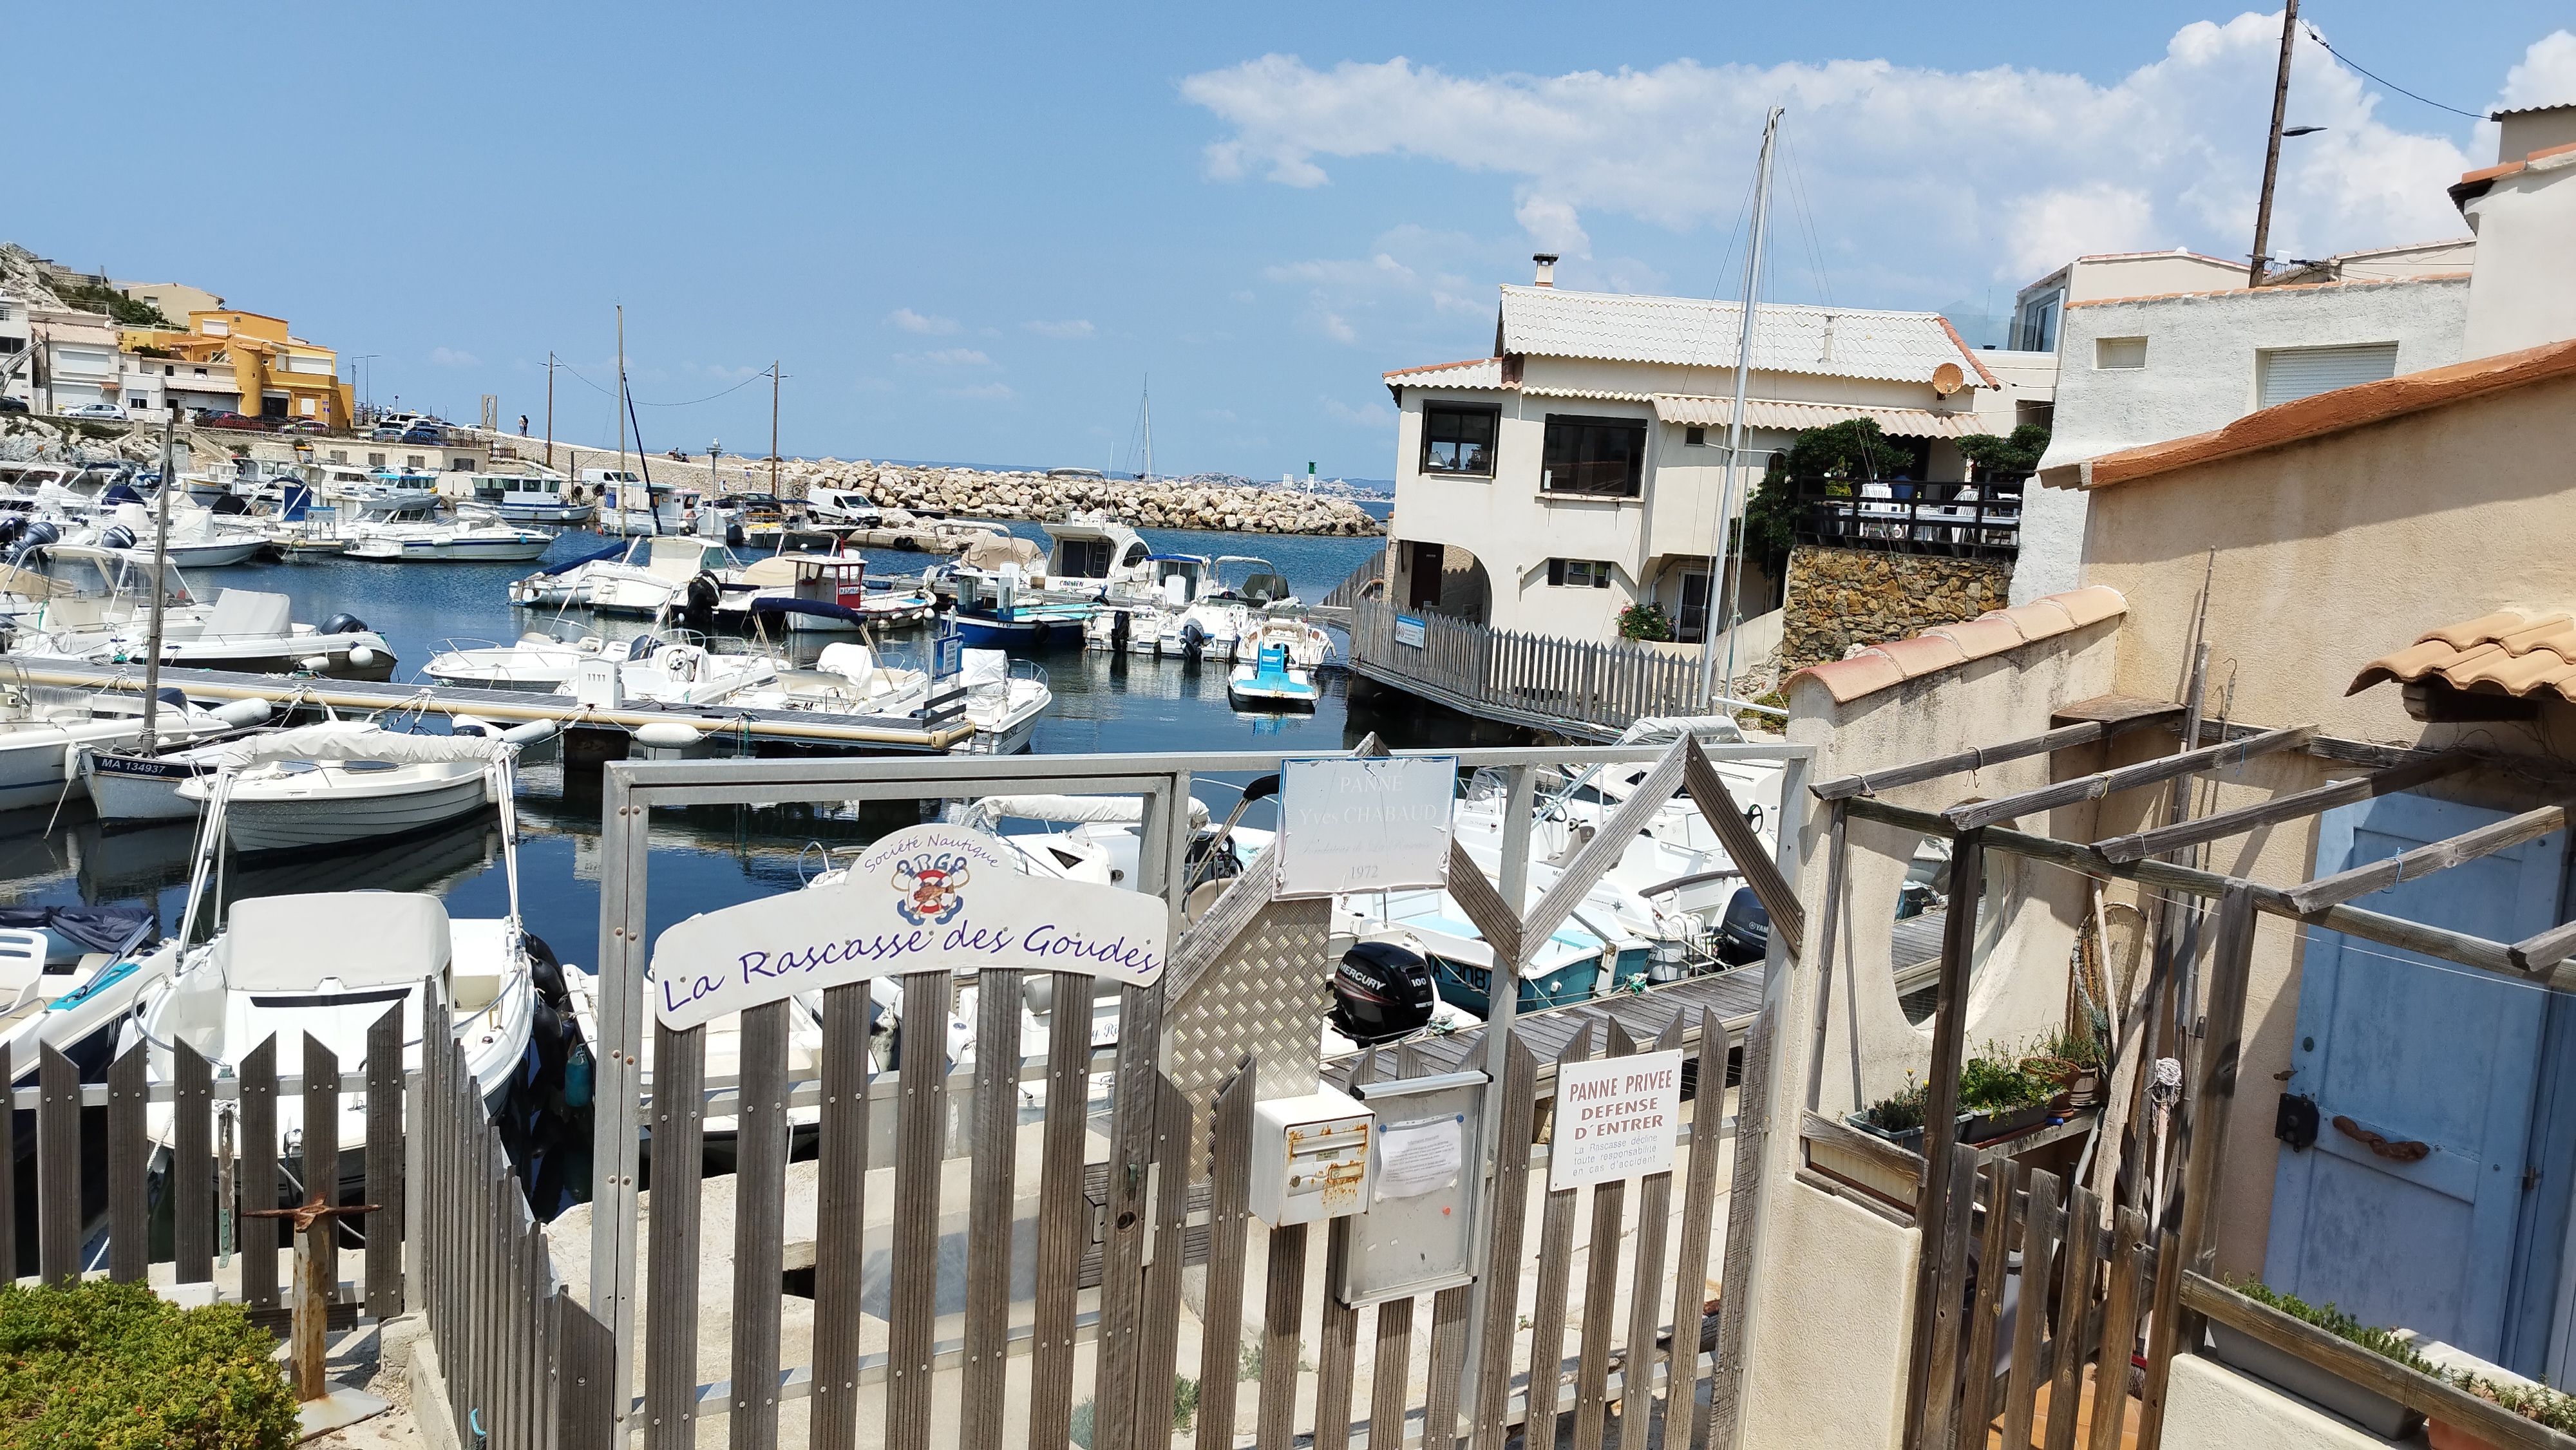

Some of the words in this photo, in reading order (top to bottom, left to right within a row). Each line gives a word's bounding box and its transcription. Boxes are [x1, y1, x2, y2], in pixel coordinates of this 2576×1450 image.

[102, 758, 121, 769] MA
[126, 762, 166, 774] 134937
[1339, 775, 1403, 793] PANNE
[1299, 809, 1338, 825] Yves
[1343, 804, 1437, 824] CHABAUD
[864, 835, 923, 873] Société
[927, 833, 999, 868] Nautique
[1352, 865, 1379, 880] 1972
[1755, 923, 1769, 933] YAM
[663, 975, 725, 1012] La
[739, 929, 934, 984] Rascasse
[943, 919, 1015, 954] des
[1023, 924, 1161, 974] Goudes
[1339, 961, 1386, 991] MERCURY
[1410, 977, 1427, 988] 100
[1569, 1077, 1618, 1103] PANNE
[1625, 1069, 1672, 1095] PRIVEE
[1581, 1097, 1658, 1121] DEFENSE
[1575, 1145, 1584, 1155] La
[1589, 1139, 1627, 1152] Rascasse
[1631, 1134, 1658, 1145] décline
[1573, 1168, 1584, 1177] en
[1589, 1163, 1605, 1174] cas
[1610, 1155, 1656, 1171] d'accident
[1574, 1154, 1595, 1165] toute
